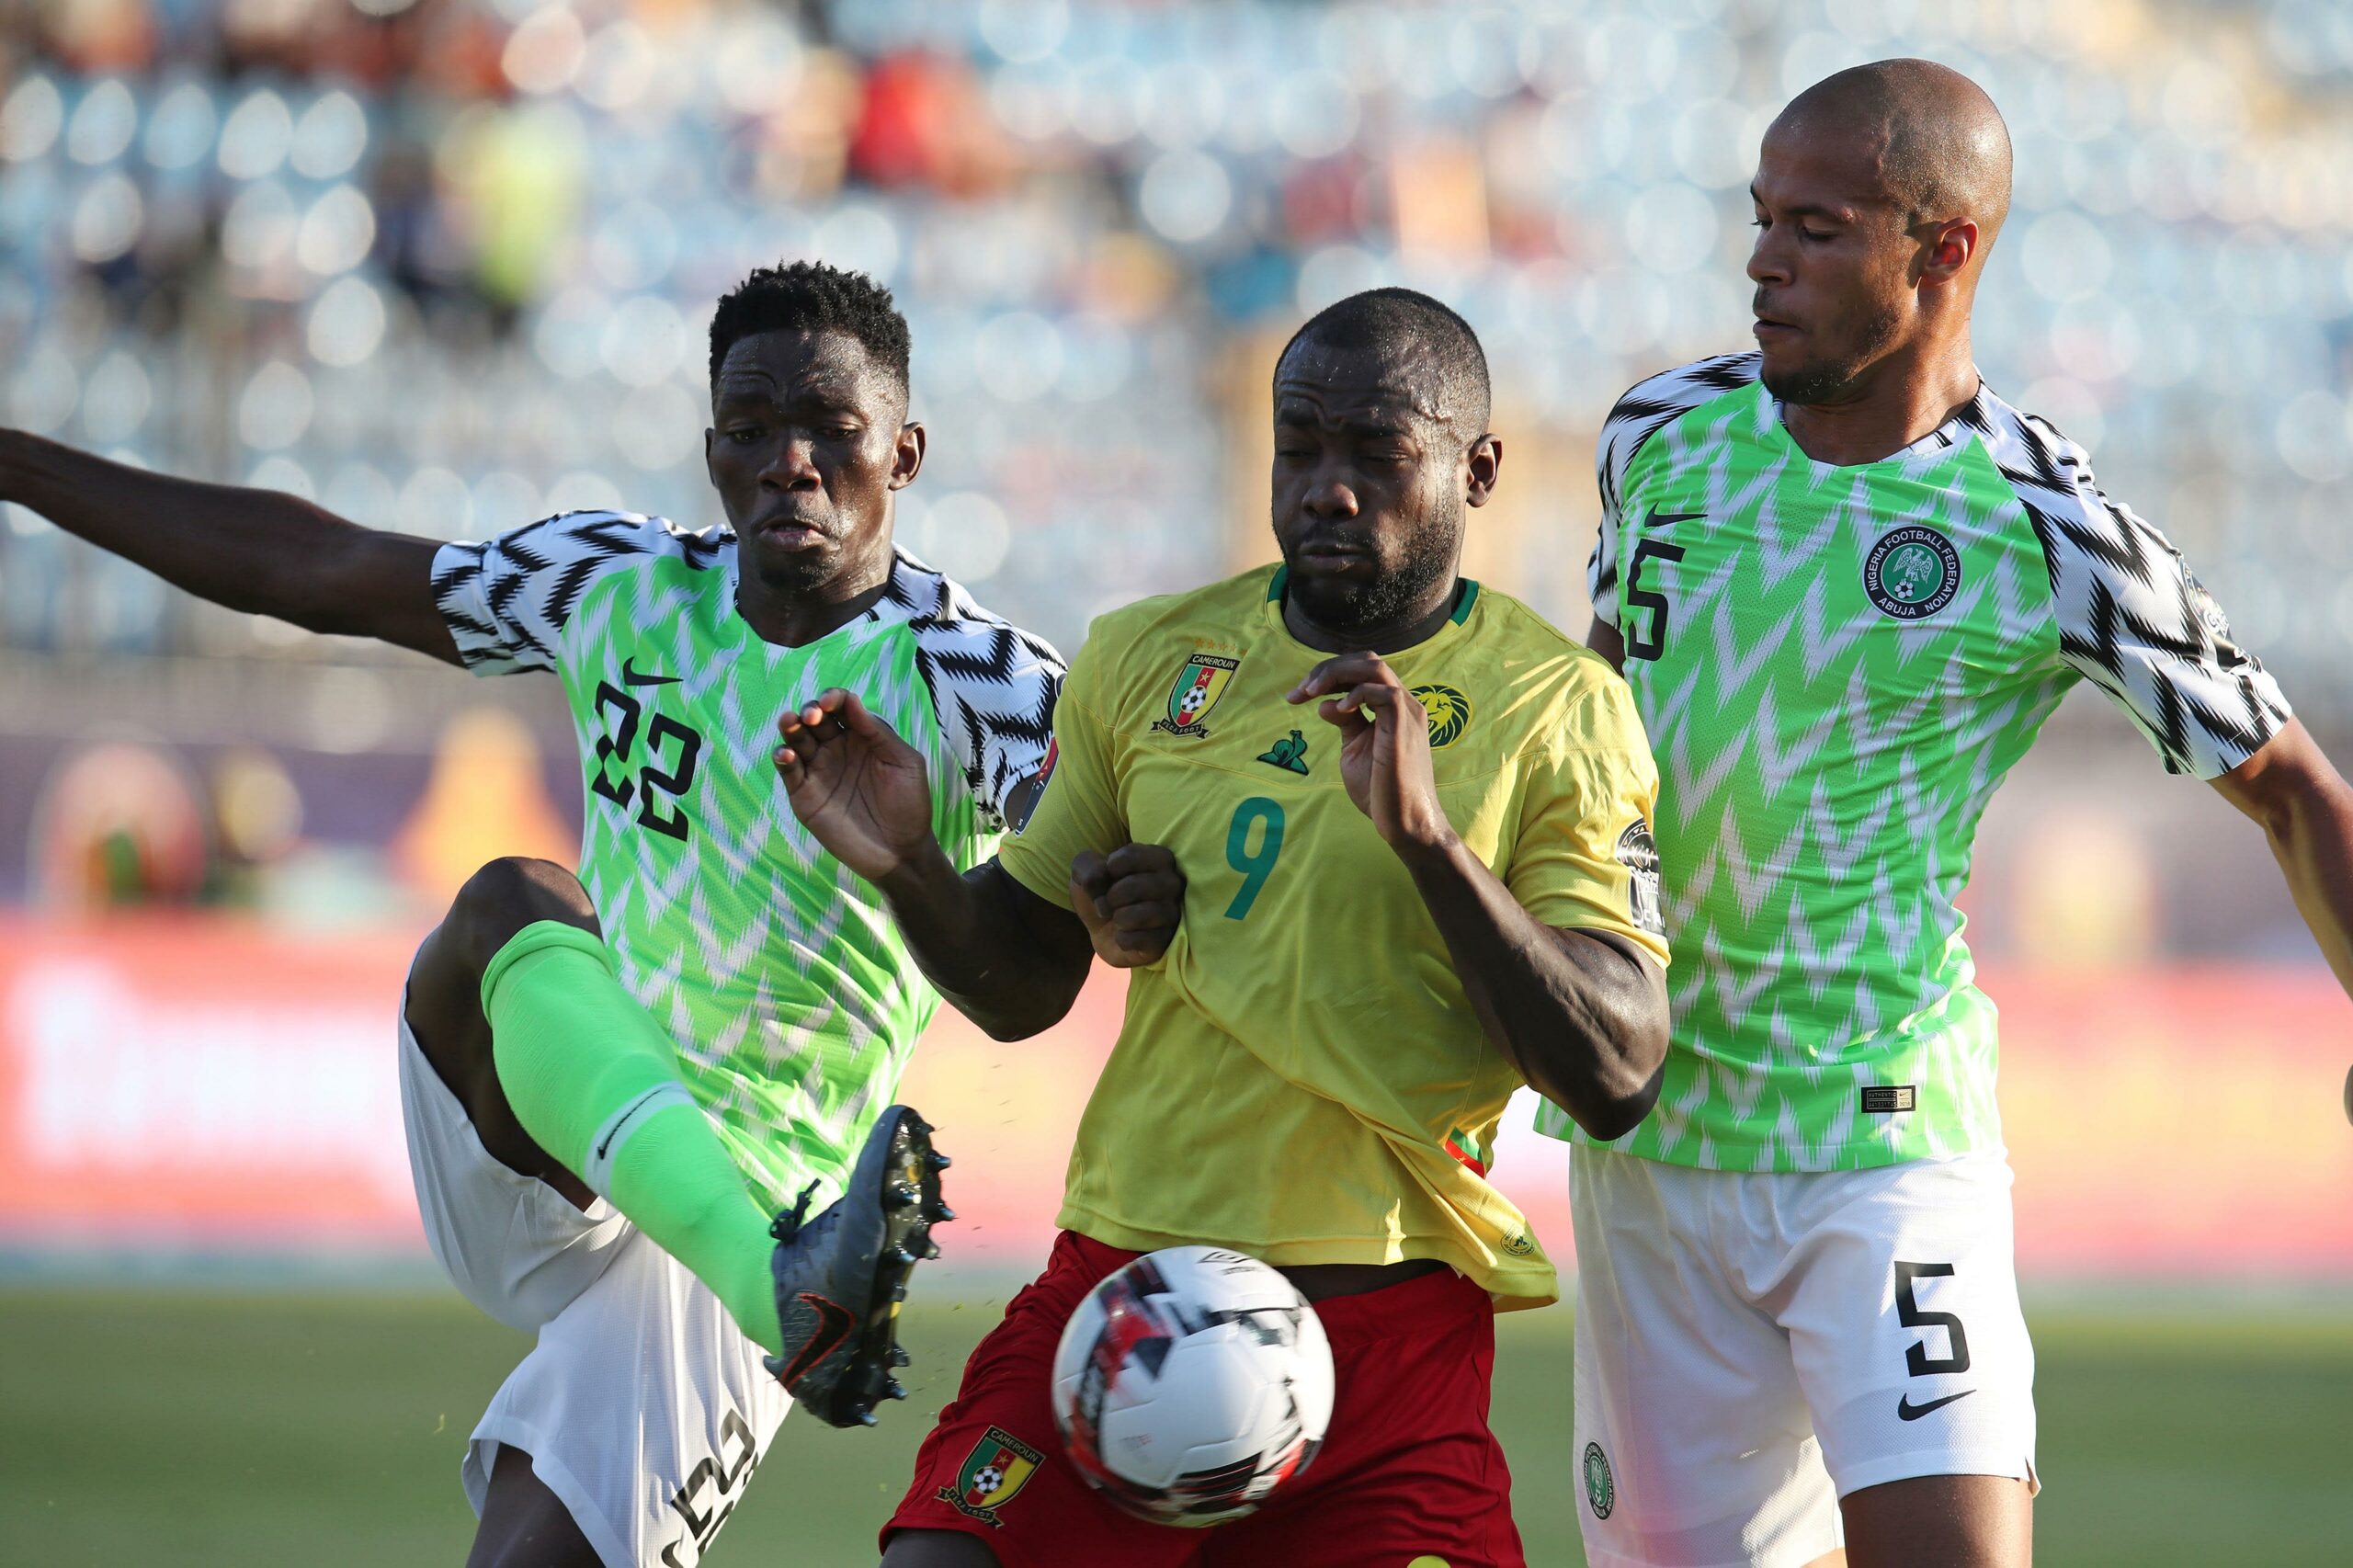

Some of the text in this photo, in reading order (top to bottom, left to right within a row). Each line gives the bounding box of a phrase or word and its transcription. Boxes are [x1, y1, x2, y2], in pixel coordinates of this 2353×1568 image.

[1627, 538, 1686, 661] 5
[1868, 530, 1957, 612] NIGERIA FOOTBALL FEDERATION
[1878, 597, 1916, 616] ABUJA
[1192, 655, 1236, 669] CAMEROUN
[591, 680, 701, 842] 22
[1224, 797, 1285, 920] 9
[1894, 1261, 1970, 1377] 5
[991, 1430, 1039, 1462] CAMEROUN
